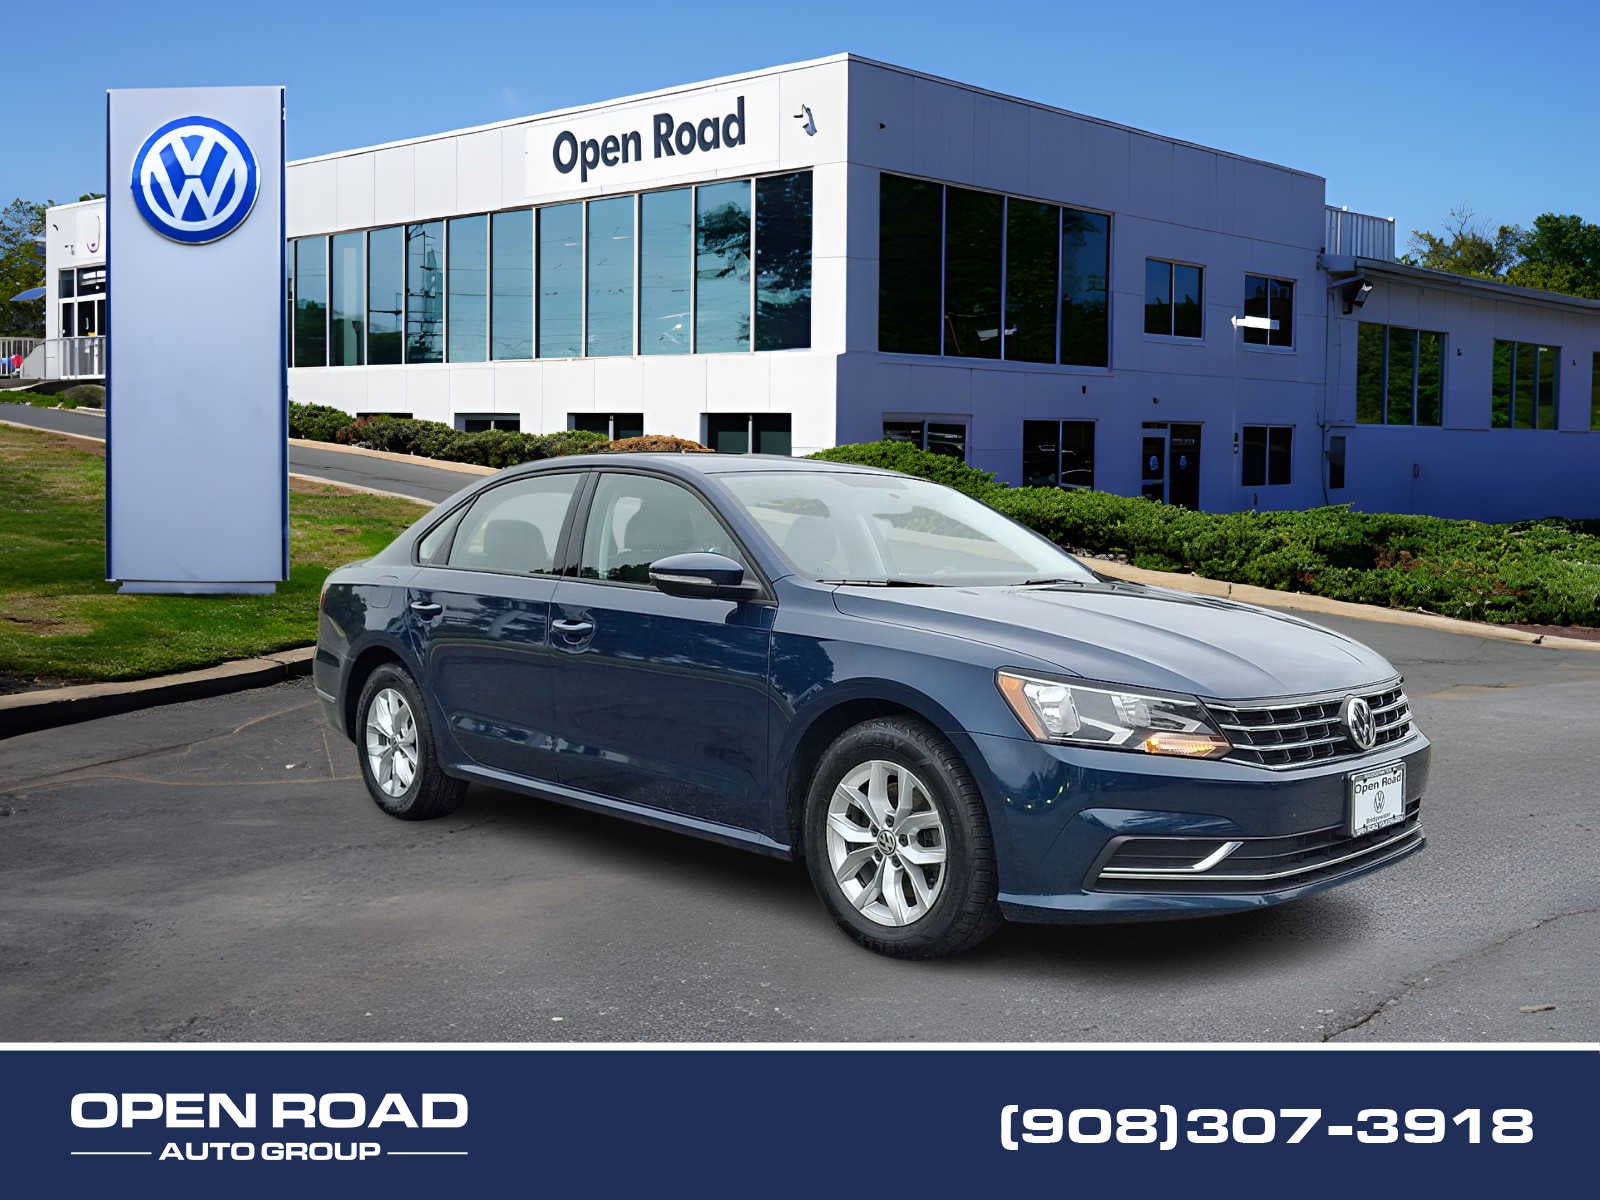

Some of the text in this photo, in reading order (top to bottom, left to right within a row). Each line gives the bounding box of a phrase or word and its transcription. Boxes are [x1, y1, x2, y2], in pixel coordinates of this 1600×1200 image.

[139, 124, 249, 232] VW
[553, 95, 746, 183] Open Road
[1354, 781, 1379, 795] Open
[1381, 771, 1402, 787] Road
